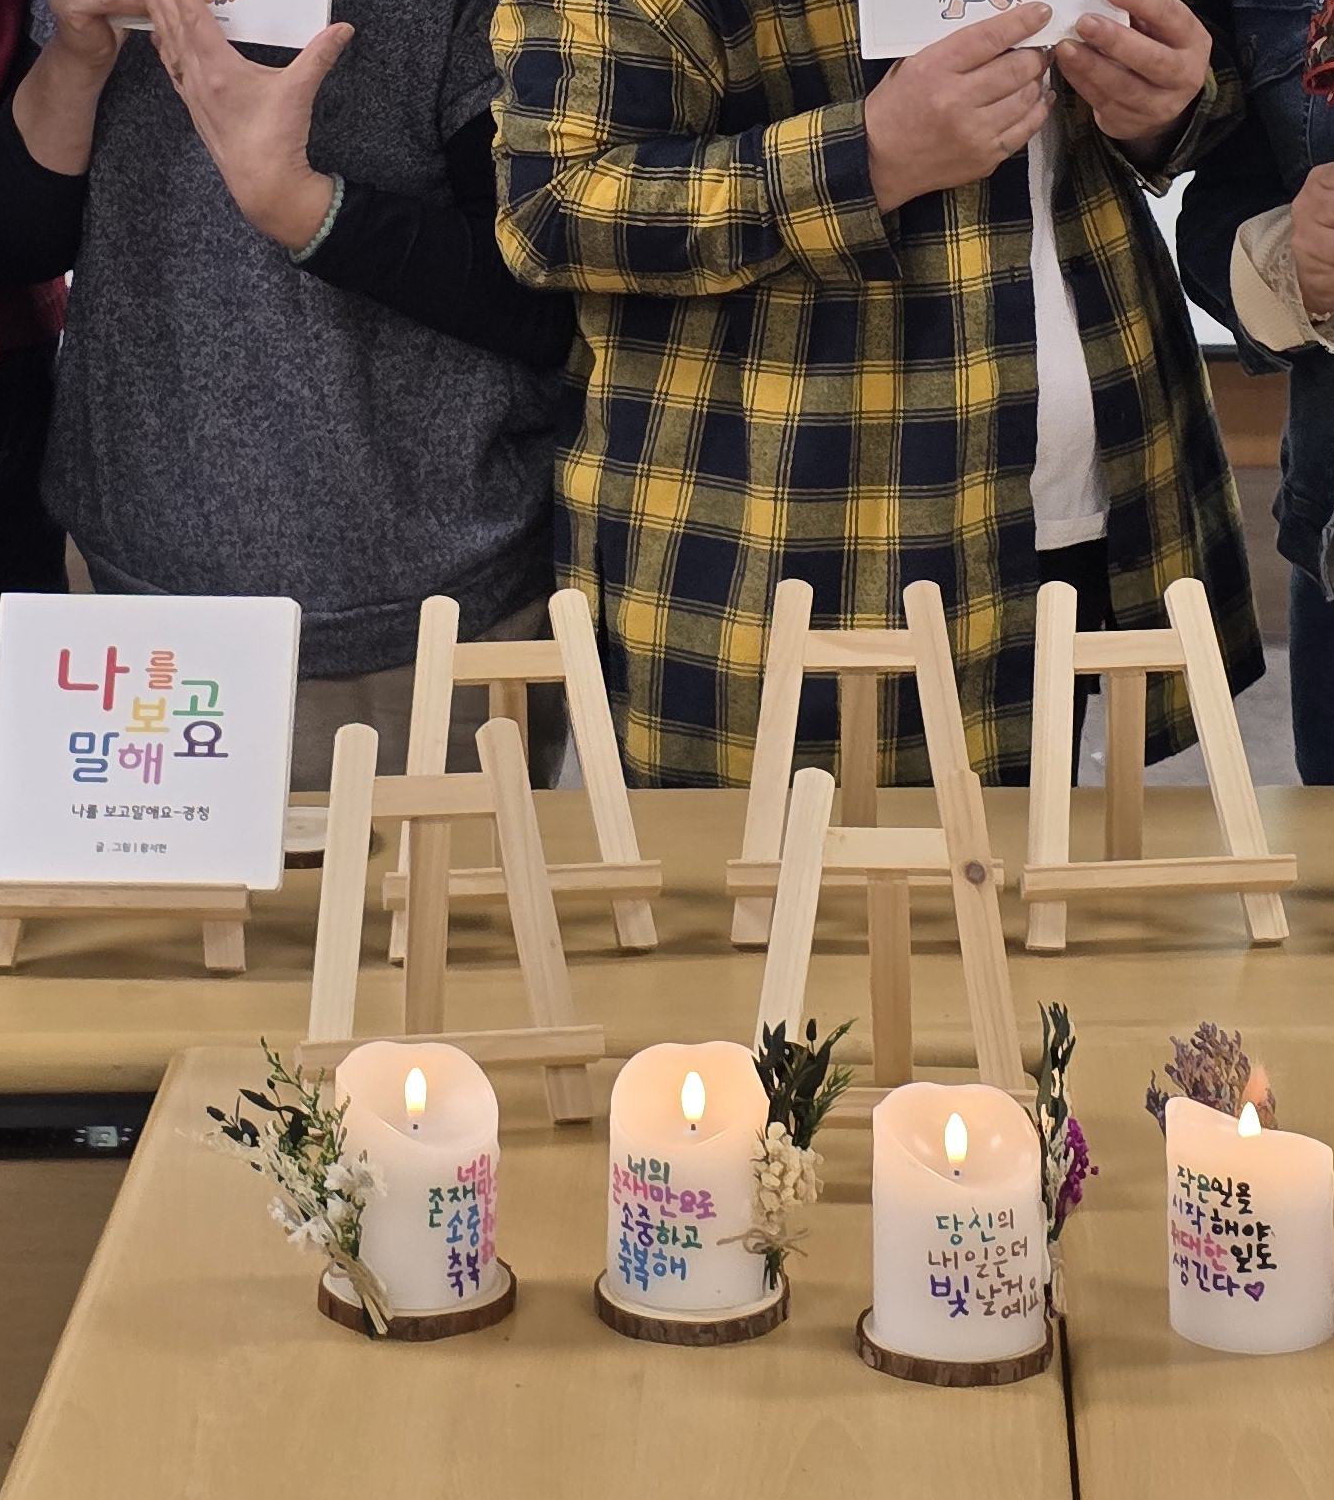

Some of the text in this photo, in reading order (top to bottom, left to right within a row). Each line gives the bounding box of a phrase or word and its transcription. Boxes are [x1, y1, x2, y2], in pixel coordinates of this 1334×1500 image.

[71, 803, 99, 819] 나를
[628, 1154, 670, 1184] 너의
[621, 1202, 702, 1249] 소중하고
[936, 1207, 1014, 1245] 당신의
[618, 1232, 686, 1292] 축복해
